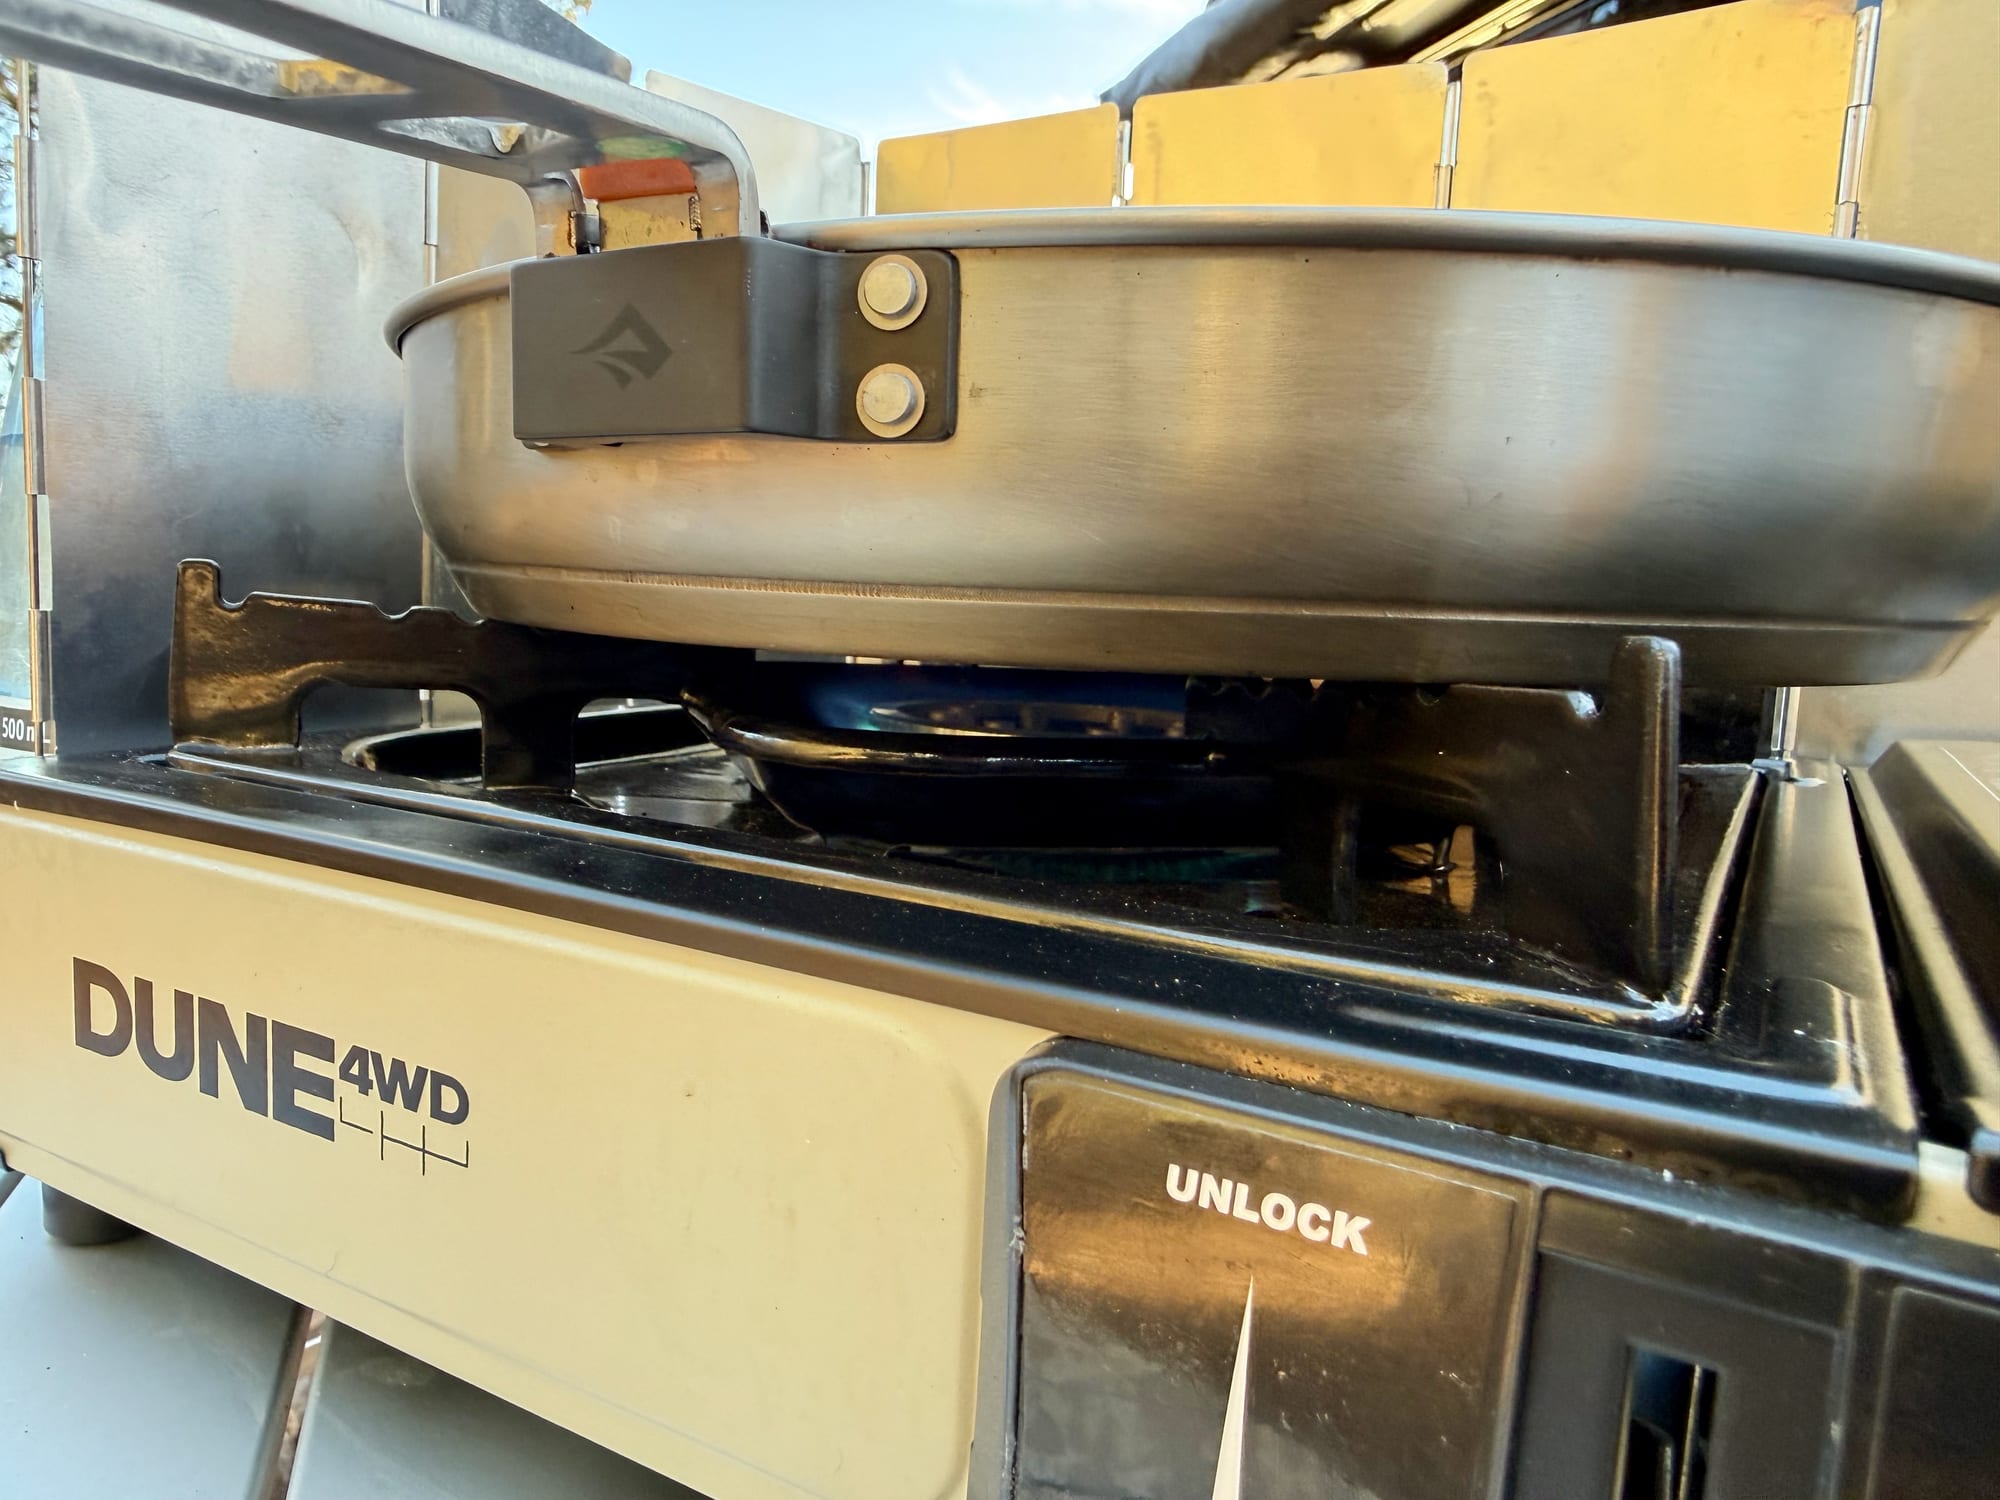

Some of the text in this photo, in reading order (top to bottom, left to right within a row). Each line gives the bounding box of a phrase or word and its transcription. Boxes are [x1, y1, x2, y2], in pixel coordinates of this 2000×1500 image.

[2, 717, 24, 741] 500
[73, 956, 470, 1142] DUNE 4WD
[1165, 1163, 1372, 1256] UNLOCK
